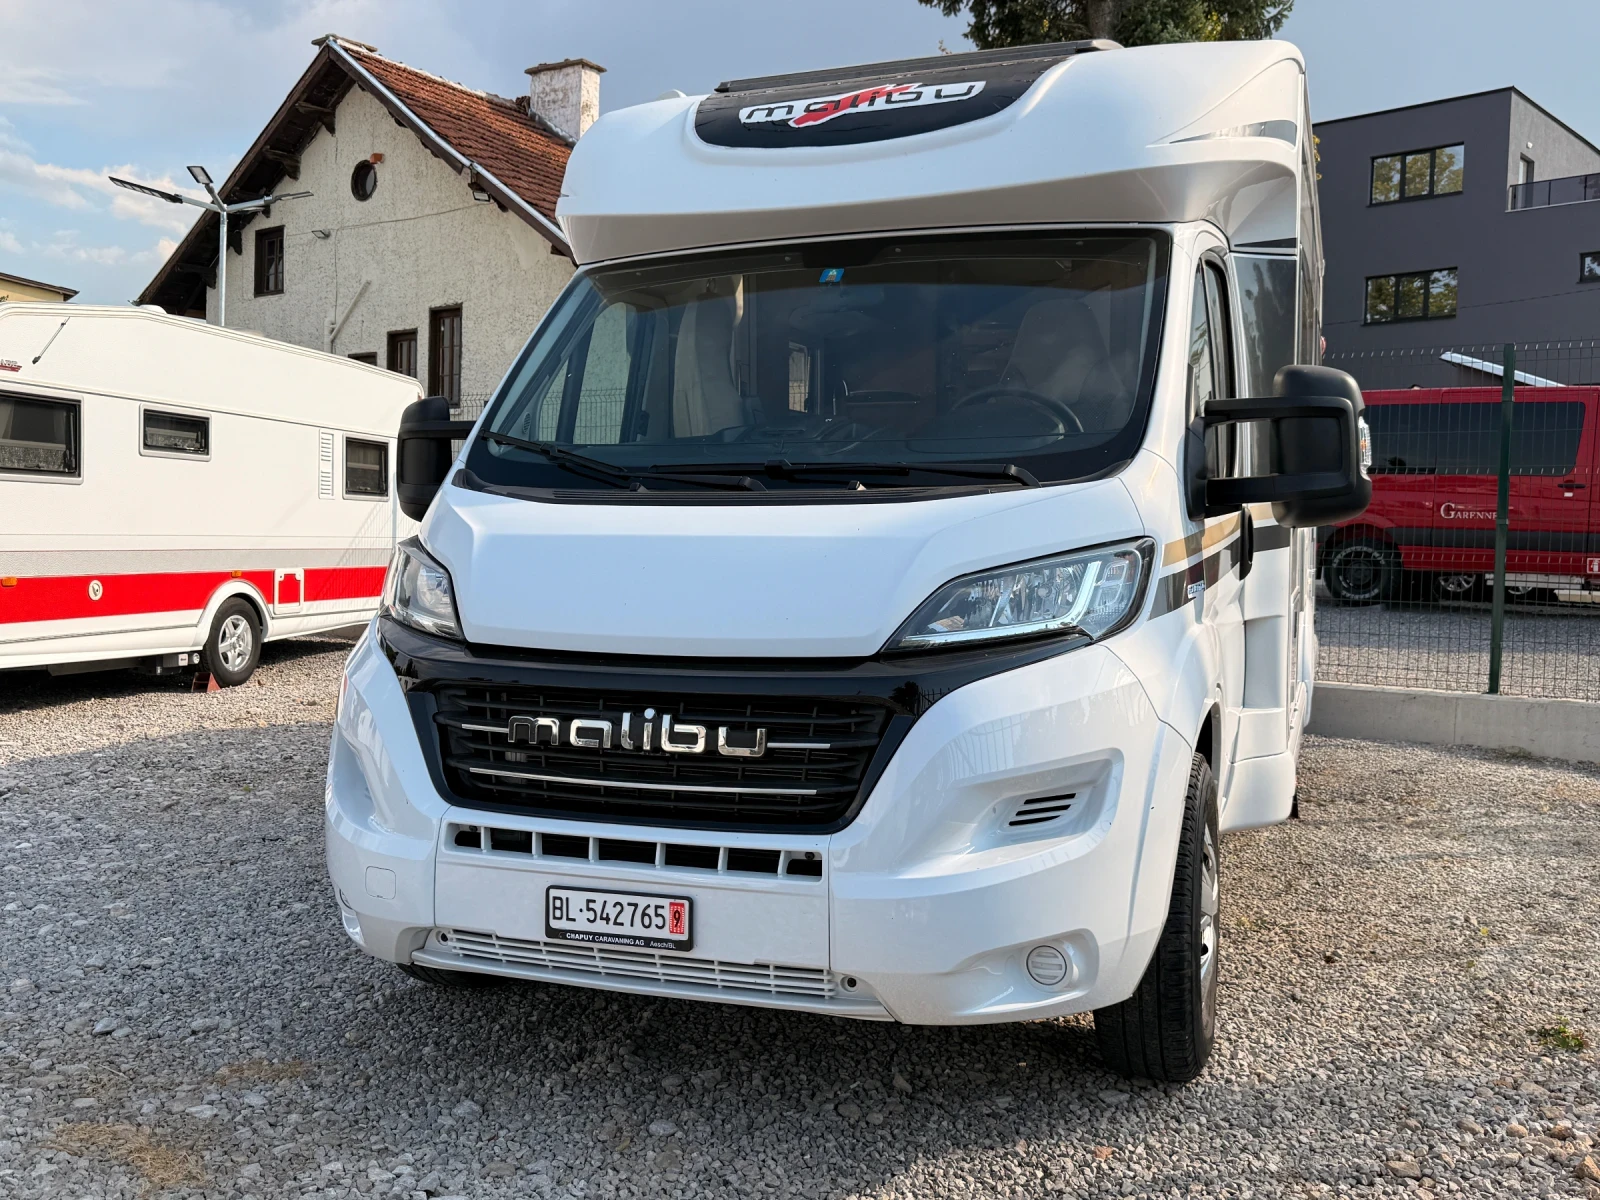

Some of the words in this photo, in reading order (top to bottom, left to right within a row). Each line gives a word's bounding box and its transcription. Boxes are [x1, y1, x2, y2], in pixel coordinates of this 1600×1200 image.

[743, 83, 979, 121] malibu
[507, 708, 767, 757] malibu
[566, 932, 593, 941] CHAPUY
[594, 936, 634, 945] CARAVANING
